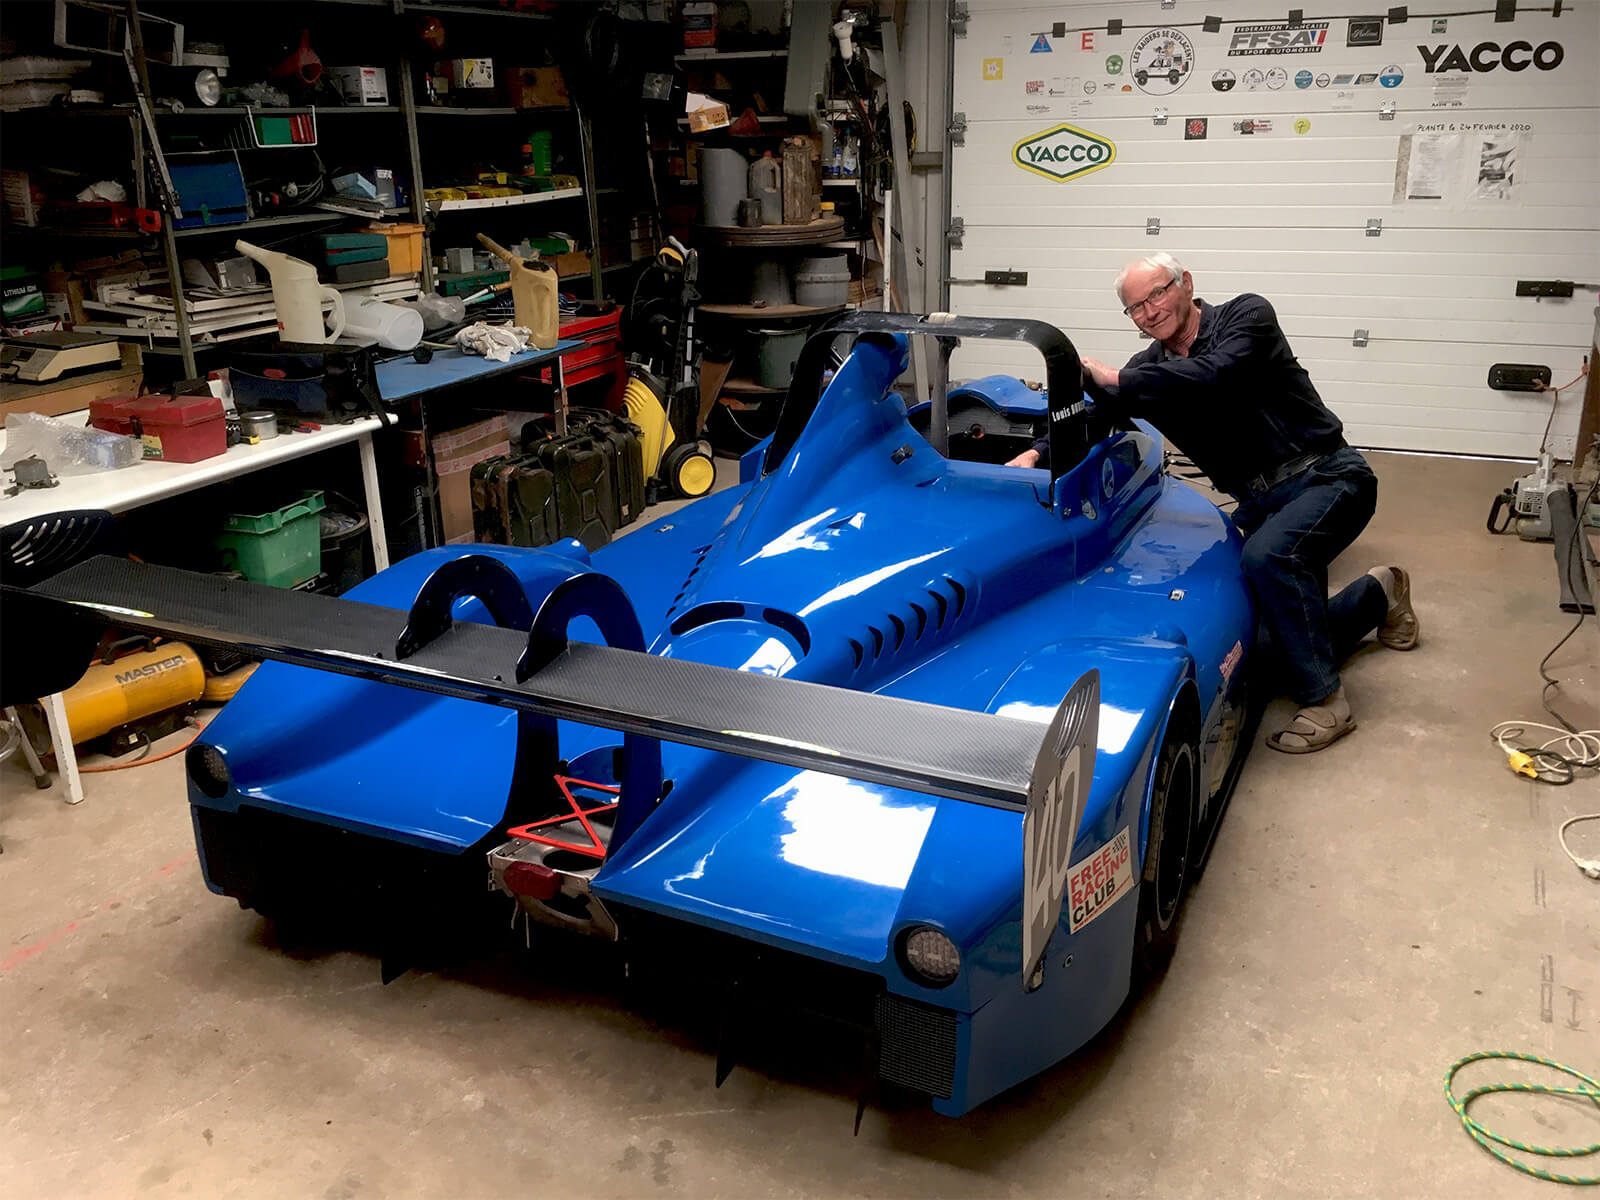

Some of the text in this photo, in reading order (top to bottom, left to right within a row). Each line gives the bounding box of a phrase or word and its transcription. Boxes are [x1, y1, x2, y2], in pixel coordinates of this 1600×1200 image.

[1236, 24, 1282, 33] FEDERATION
[1081, 32, 1094, 50] E
[1132, 51, 1141, 64] LES
[1137, 31, 1161, 51] RAIDERS
[1162, 30, 1170, 38] SE
[1230, 31, 1311, 49] FFSA
[1271, 46, 1320, 54] AUTOMOBILE
[1417, 41, 1564, 73] YACCO
[1222, 82, 1229, 90] 2
[1388, 78, 1395, 86] 2
[1510, 123, 1532, 131] 2020
[1026, 144, 1103, 162] YACCO
[1052, 407, 1070, 422] Louis
[114, 655, 187, 684] MASTER
[1071, 847, 1111, 893] FREE
[1072, 846, 1129, 910] RACING
[1073, 877, 1116, 924] CLUB
